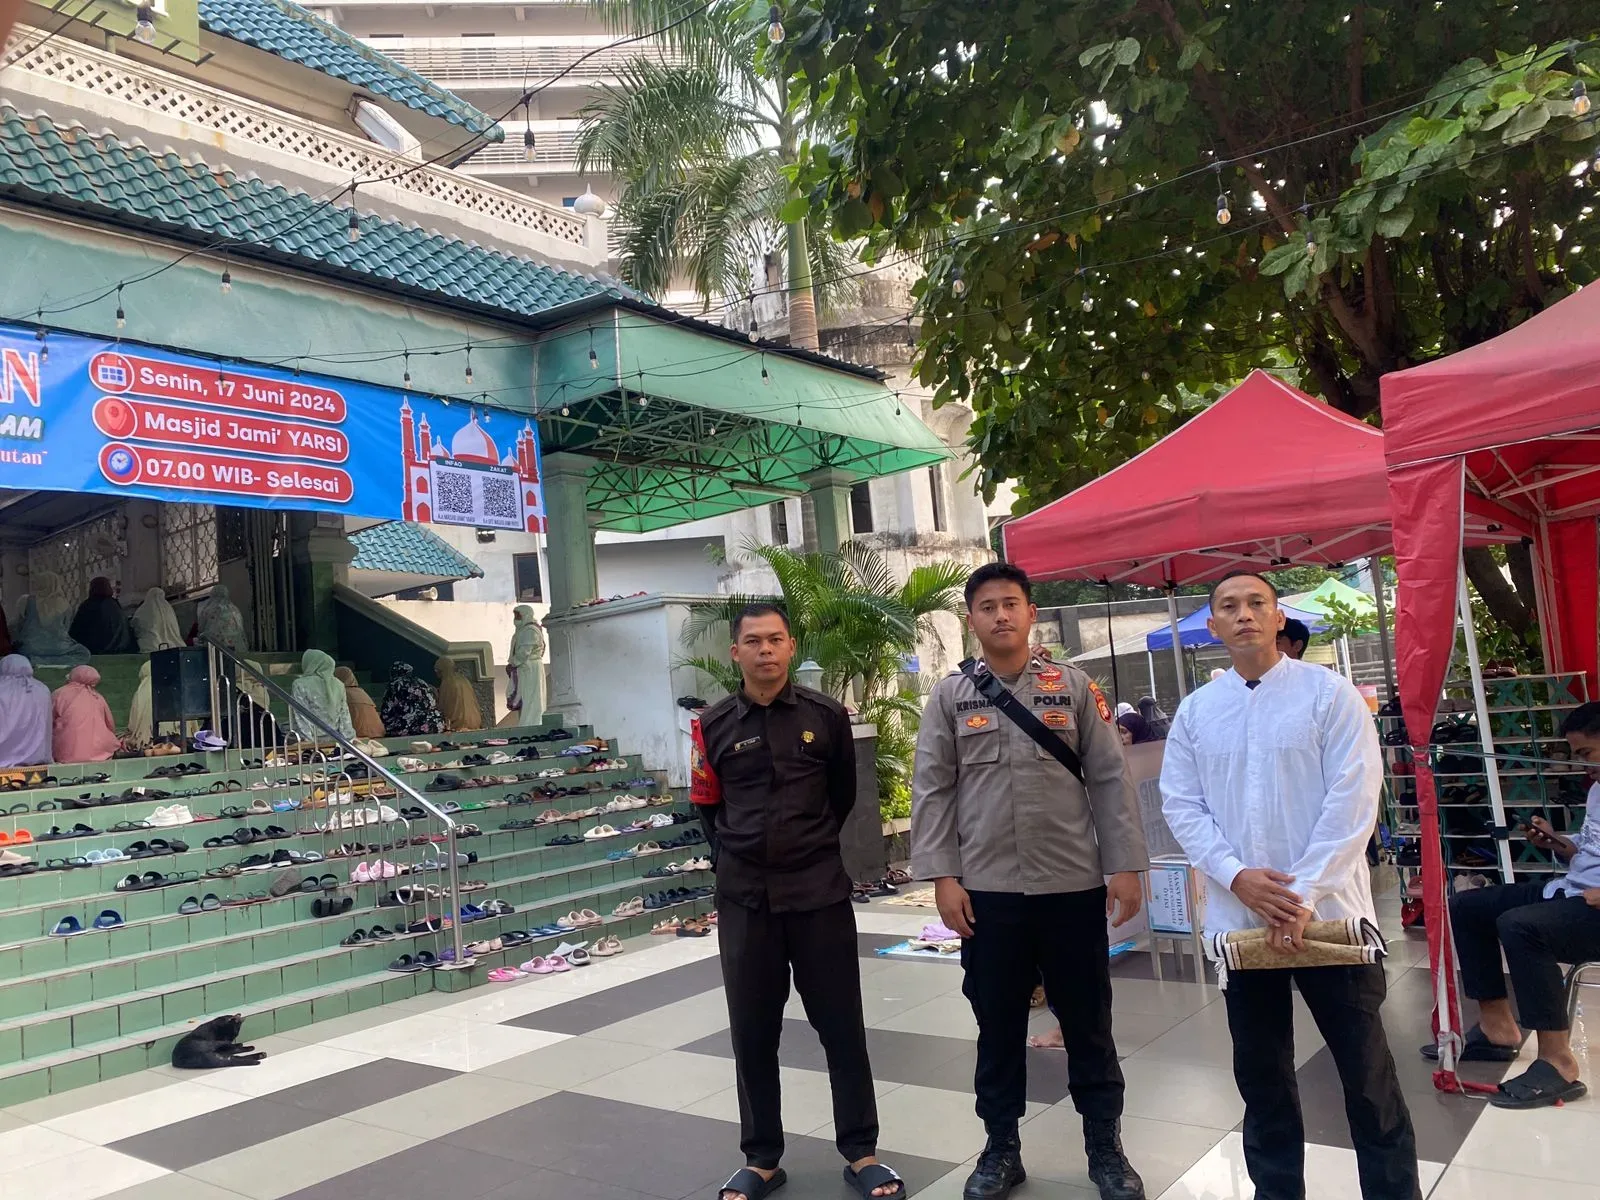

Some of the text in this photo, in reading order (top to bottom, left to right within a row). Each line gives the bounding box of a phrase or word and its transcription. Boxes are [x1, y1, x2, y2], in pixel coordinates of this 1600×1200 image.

[0, 348, 41, 407] N
[140, 367, 336, 413] Senin, 17 Juni 2024
[144, 411, 342, 453] Masjid Jami' YARSI
[146, 458, 340, 494] 07.00 WIB- Selesai
[489, 465, 507, 474] ZAKAT
[1033, 695, 1071, 707] POLRI
